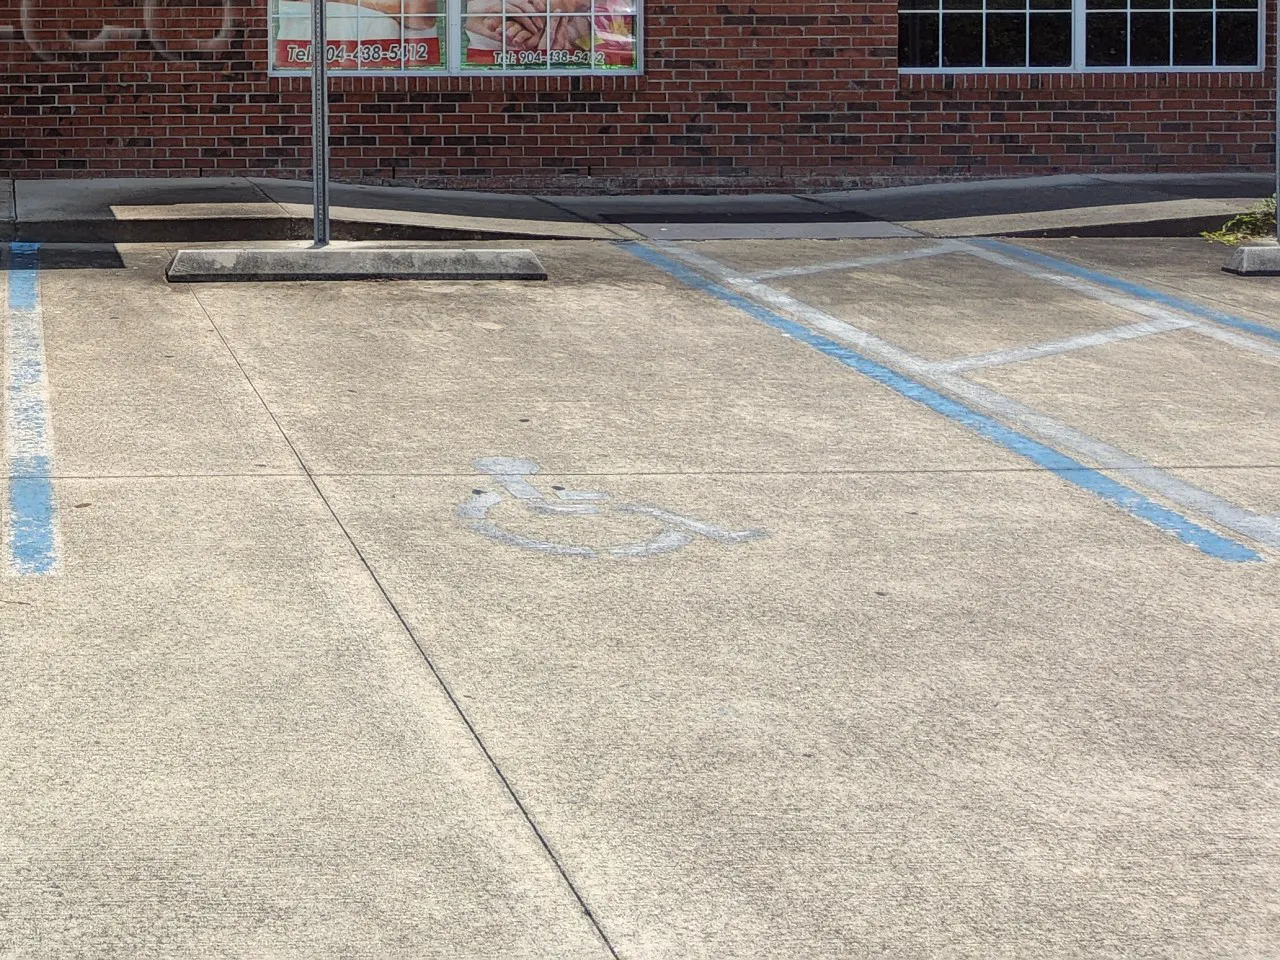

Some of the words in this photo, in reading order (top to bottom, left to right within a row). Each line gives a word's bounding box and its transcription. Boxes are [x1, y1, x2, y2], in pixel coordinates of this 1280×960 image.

[325, 43, 428, 63] 04-438-5412
[494, 51, 517, 64] Tel:
[519, 50, 605, 65] 904-438-542
